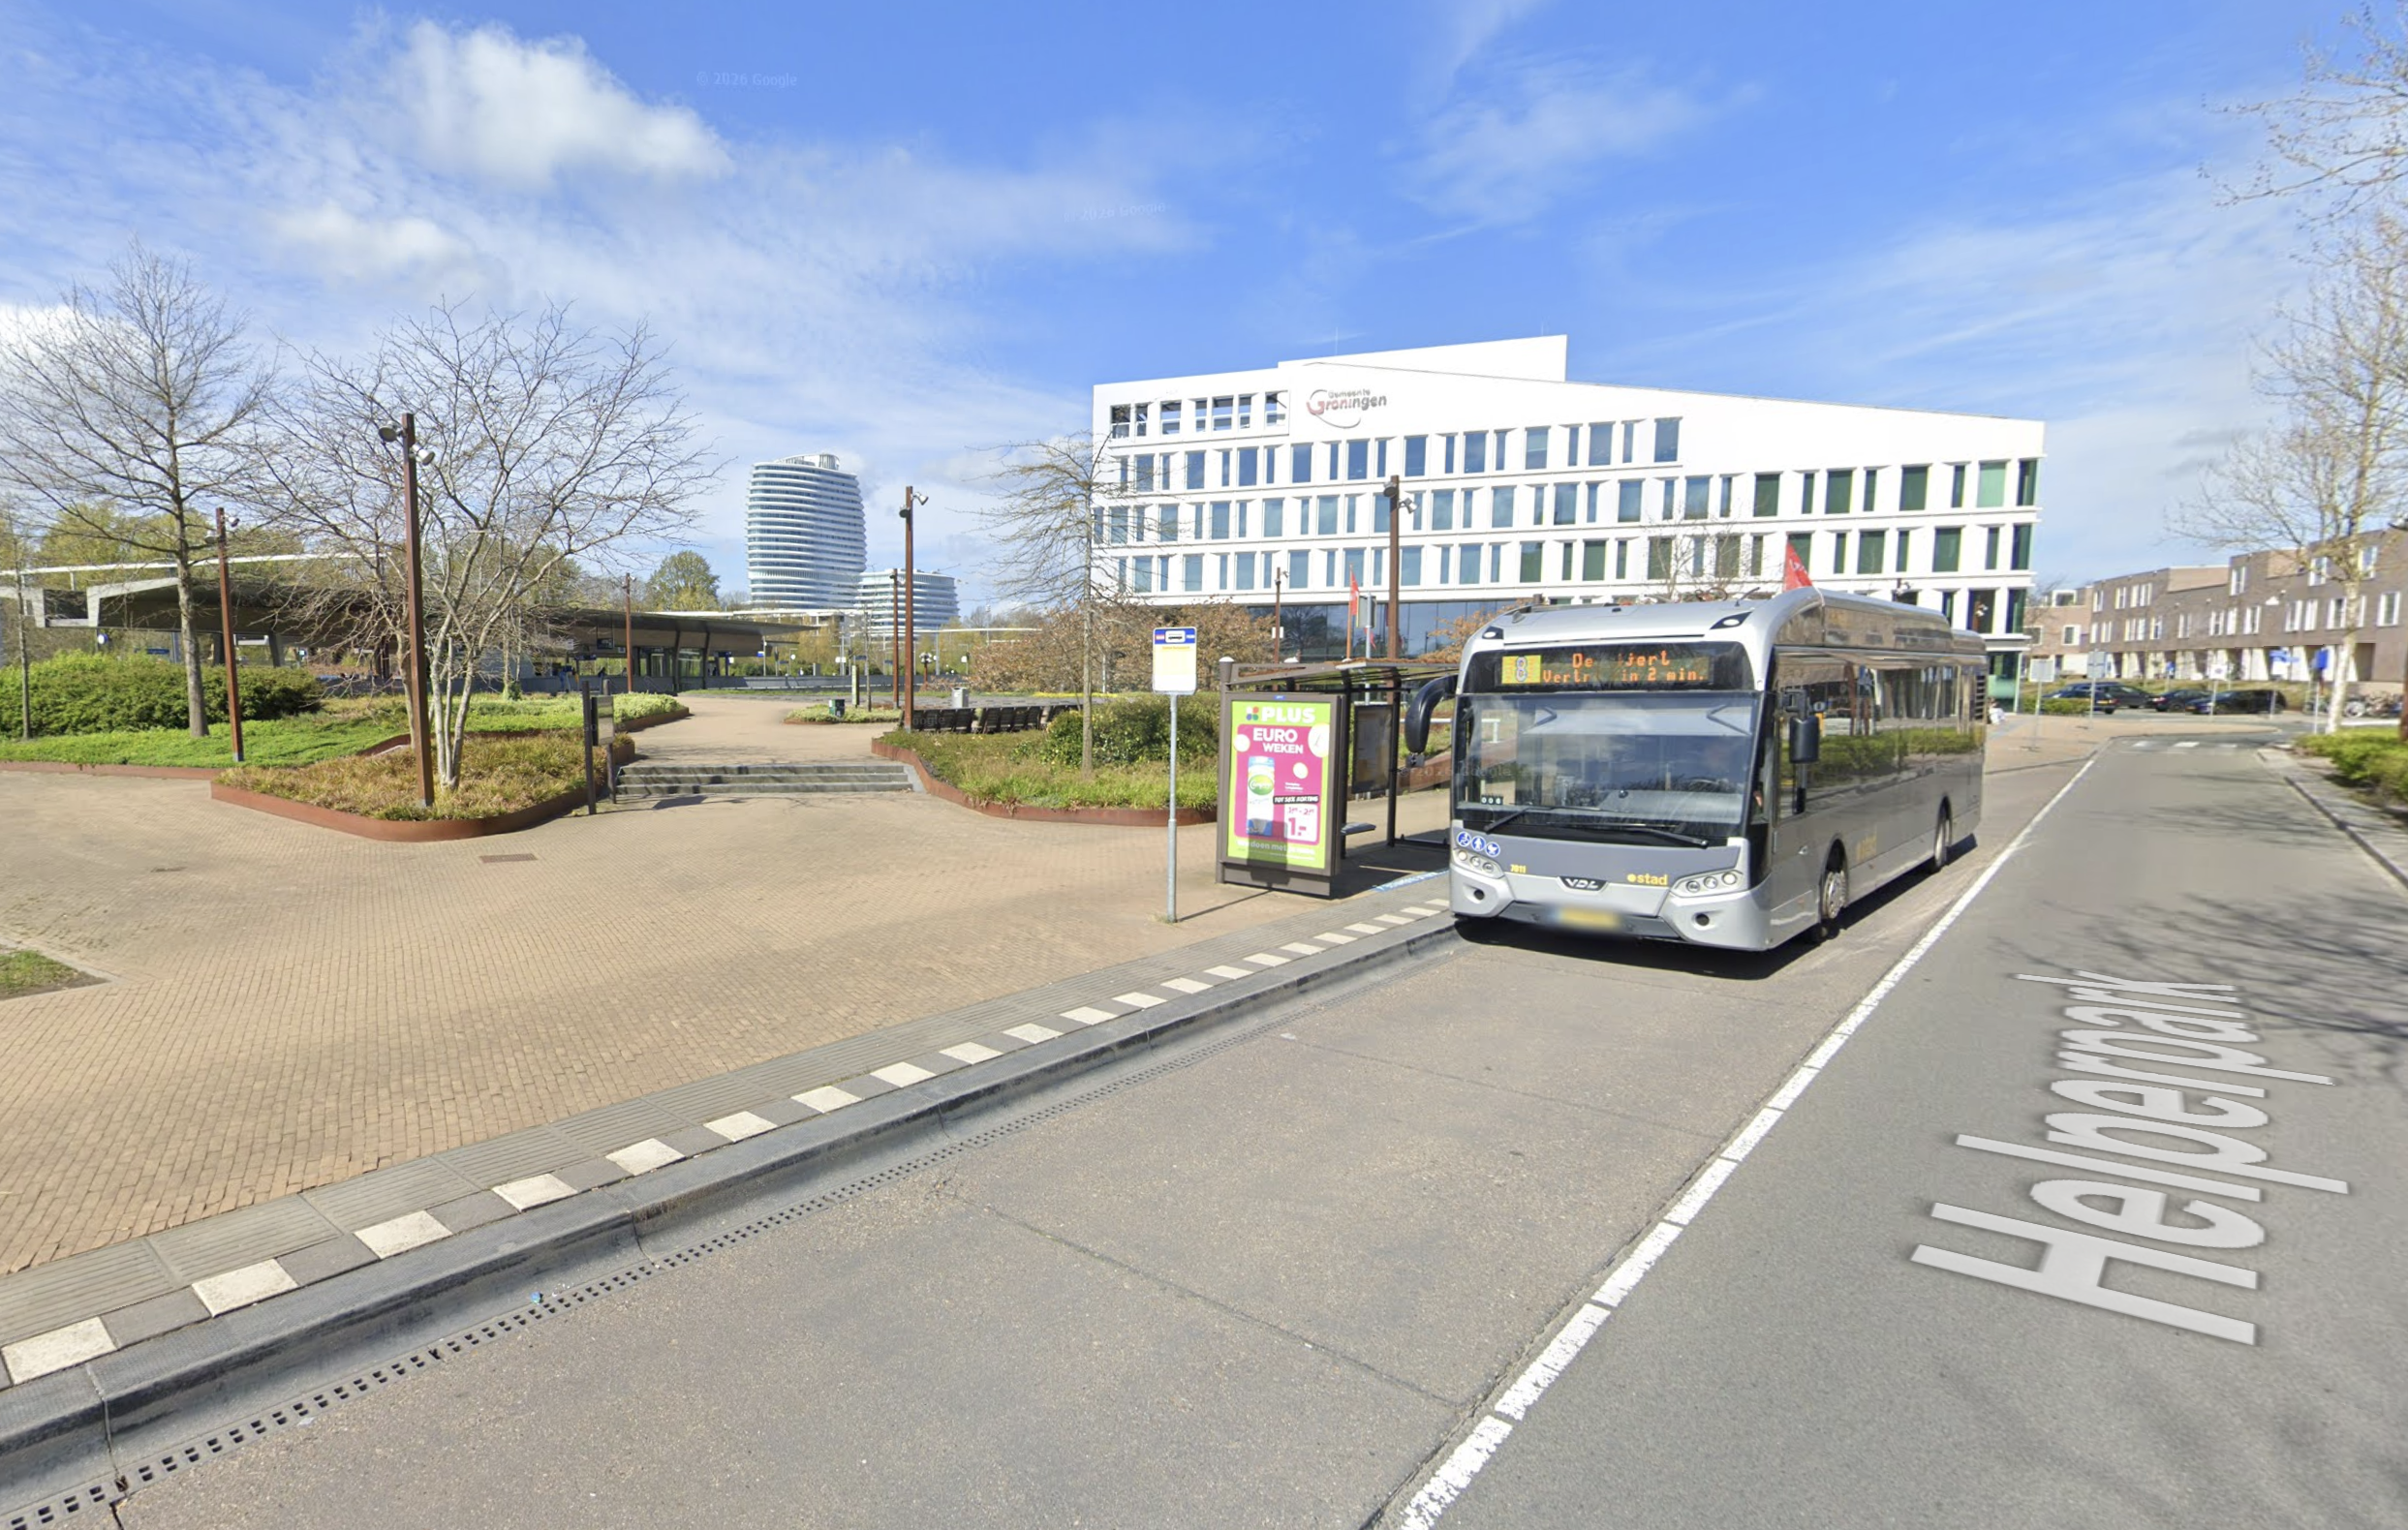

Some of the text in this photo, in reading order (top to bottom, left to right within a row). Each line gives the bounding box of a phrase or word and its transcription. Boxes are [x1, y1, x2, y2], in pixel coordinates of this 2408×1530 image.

[1328, 388, 1371, 399] Gemeente
[1306, 390, 1387, 415] Groningen
[1572, 653, 1593, 668] De
[1516, 657, 1528, 683] 8
[1621, 668, 1639, 682] in
[1648, 666, 1656, 682] 2
[1666, 667, 1703, 682] min.
[1261, 707, 1316, 723] PLUS
[1252, 727, 1298, 743] EURO
[1262, 743, 1304, 754] WEKEN
[1250, 841, 1270, 850] doen
[1564, 877, 1599, 890] VDL
